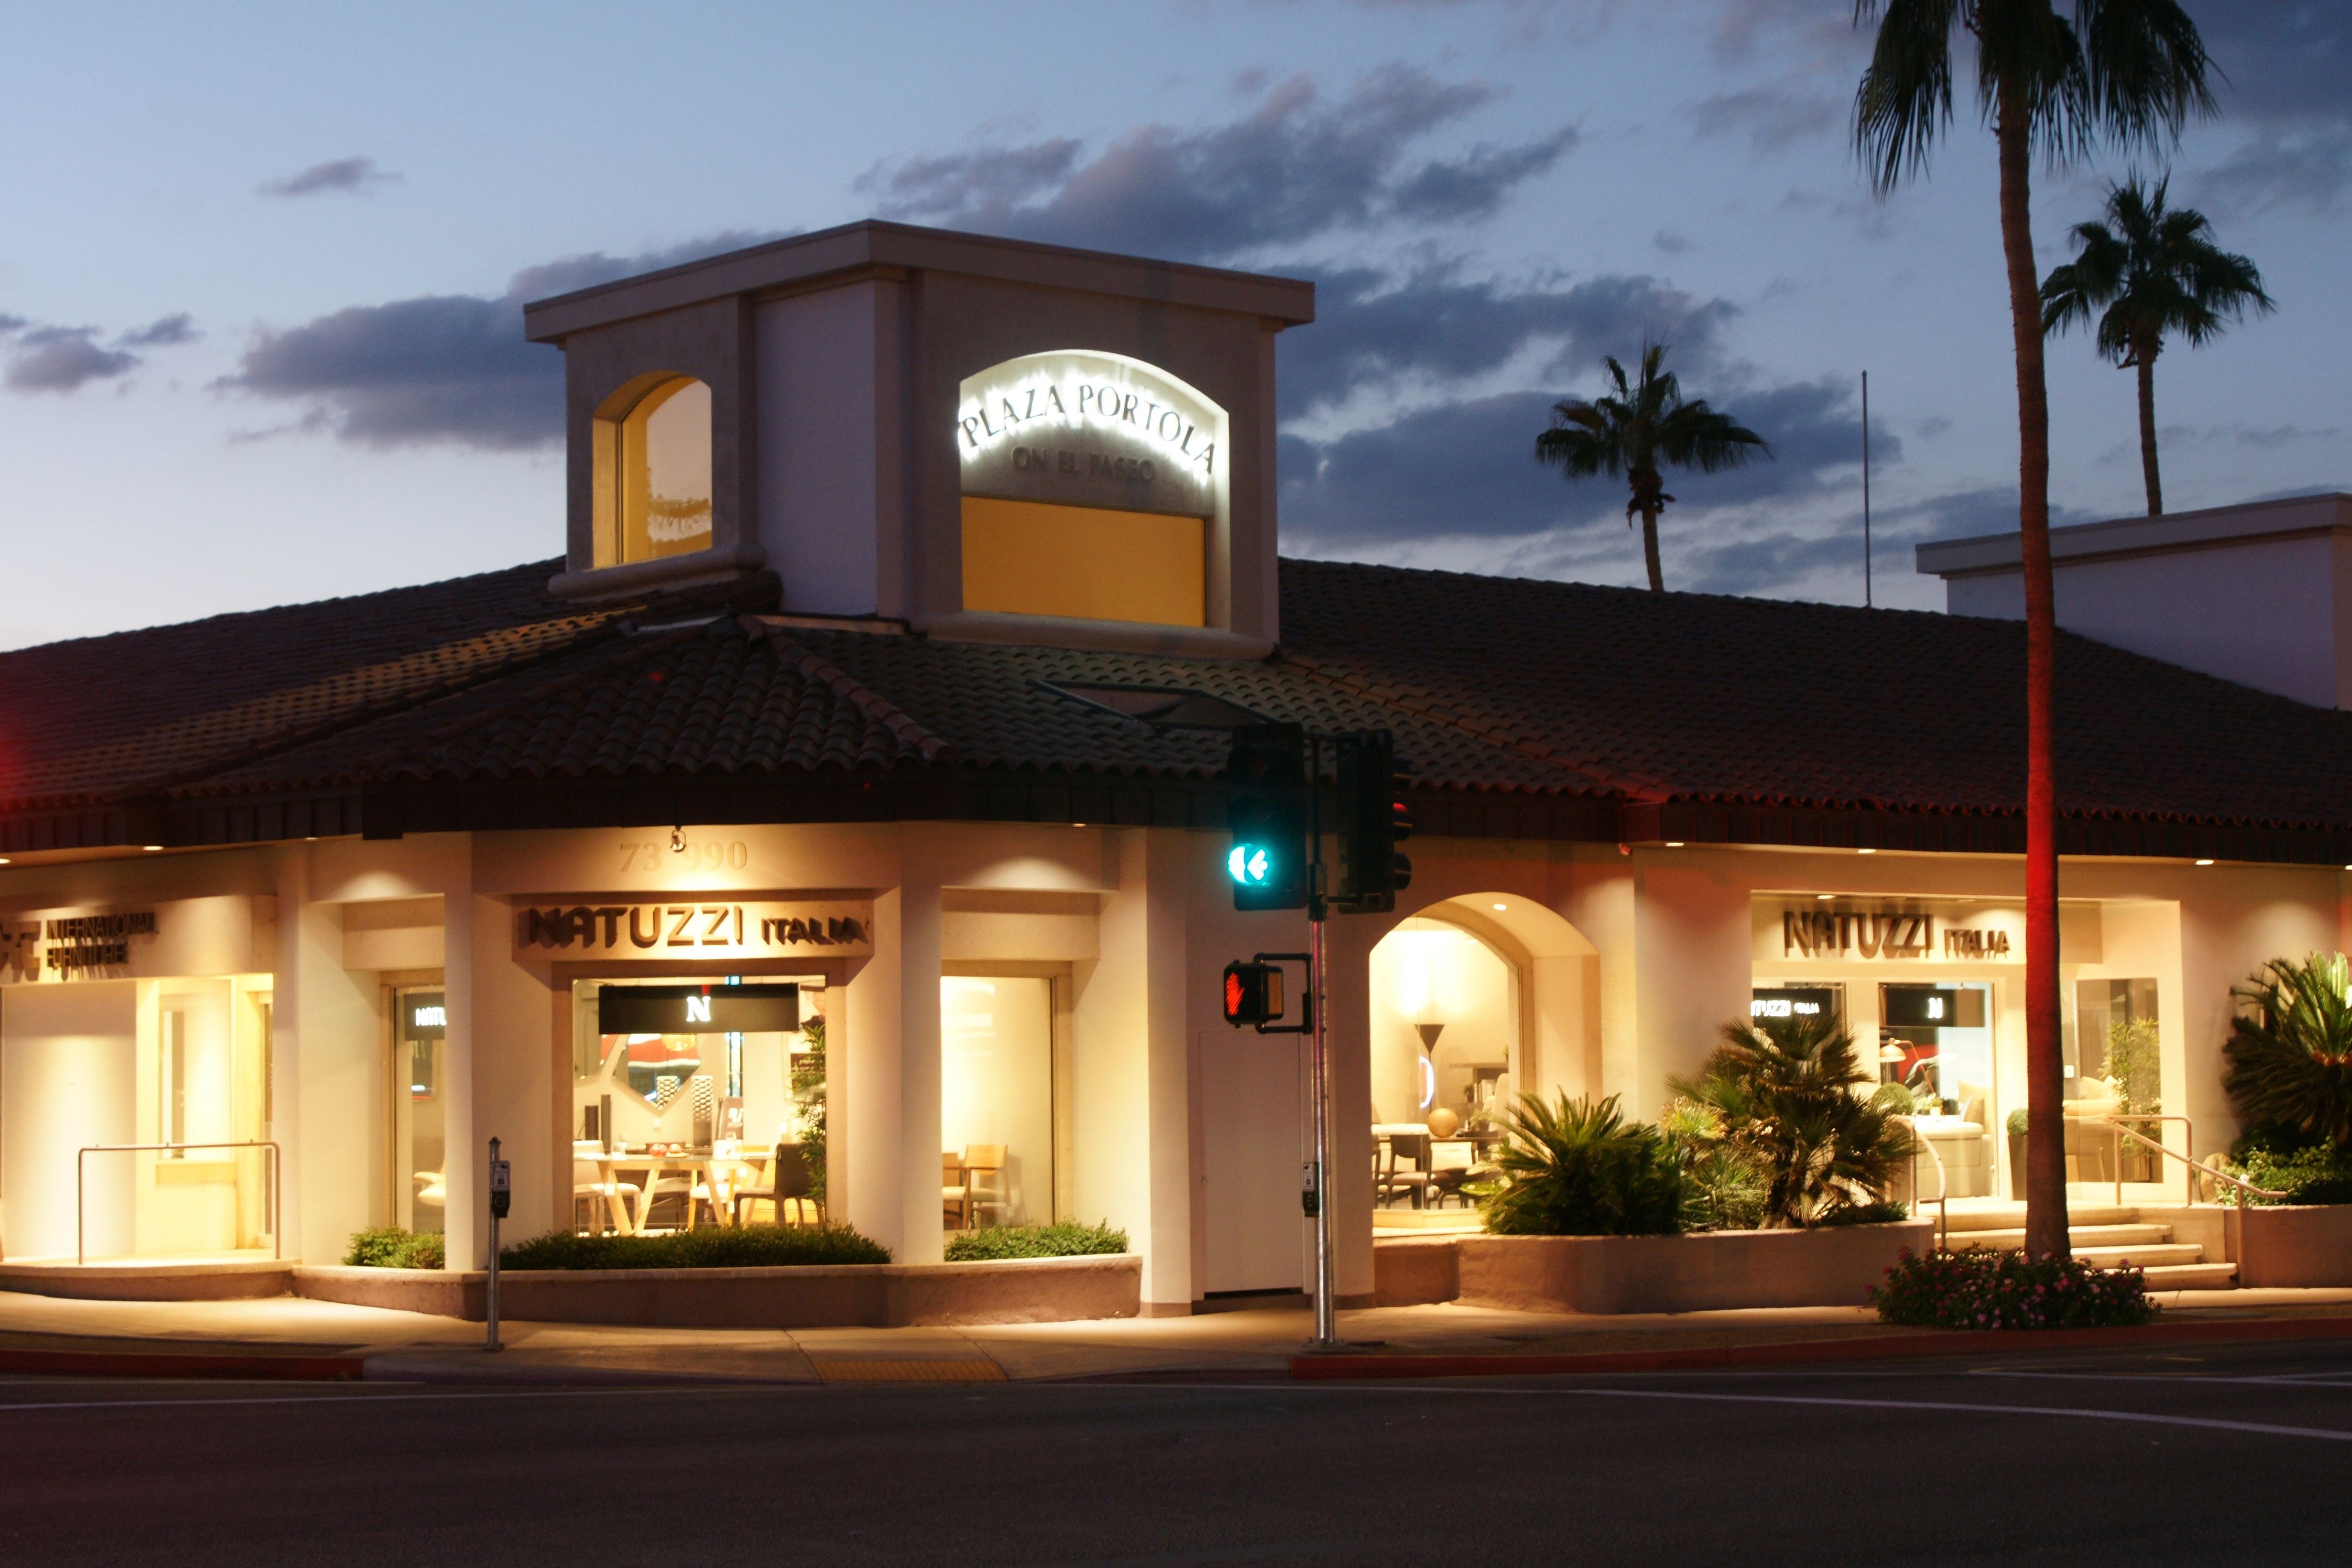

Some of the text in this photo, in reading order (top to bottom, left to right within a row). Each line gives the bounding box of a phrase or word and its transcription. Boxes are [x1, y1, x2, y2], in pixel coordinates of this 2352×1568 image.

[960, 385, 1215, 474] PLAZA PORTOLA
[1012, 446, 1156, 480] ON EL PASEO
[620, 840, 748, 872] 73 990
[47, 912, 155, 939] INTERNATIONAL
[520, 906, 868, 949] NATUZZI ITALIA
[1784, 910, 2011, 953] NATUZZI ITALIA
[47, 941, 129, 967] FURNITURE
[686, 996, 711, 1021] N
